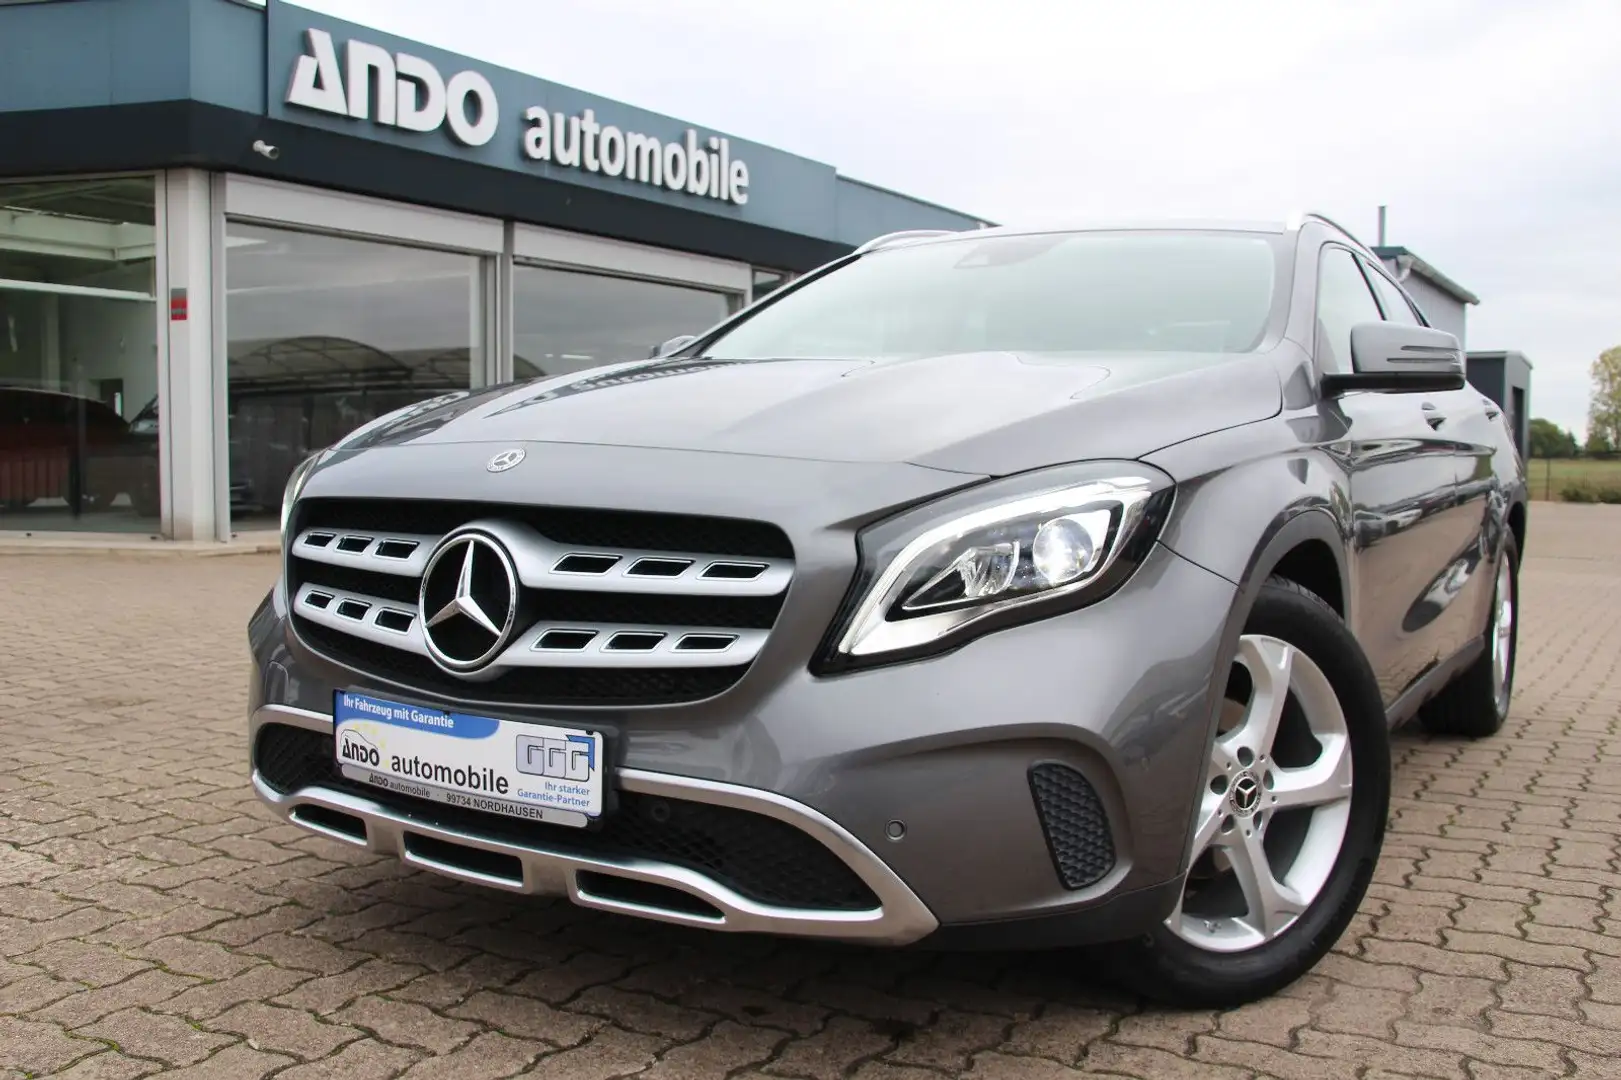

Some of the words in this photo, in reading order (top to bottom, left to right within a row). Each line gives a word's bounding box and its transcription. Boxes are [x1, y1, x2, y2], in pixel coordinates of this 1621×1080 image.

[286, 27, 499, 146] ANDO
[524, 106, 749, 205] automobile
[343, 694, 354, 707] Ihr
[355, 699, 393, 719] Fahrzeug
[394, 707, 410, 721] mit
[411, 710, 454, 728] Garantie
[391, 755, 509, 795] automobile
[544, 781, 557, 792] Ihr
[558, 783, 590, 796] starker
[390, 780, 430, 798] automobile
[446, 793, 472, 806] 99734
[473, 798, 543, 819] NORDHAUSEN
[517, 788, 590, 807] Garantie-Partner
